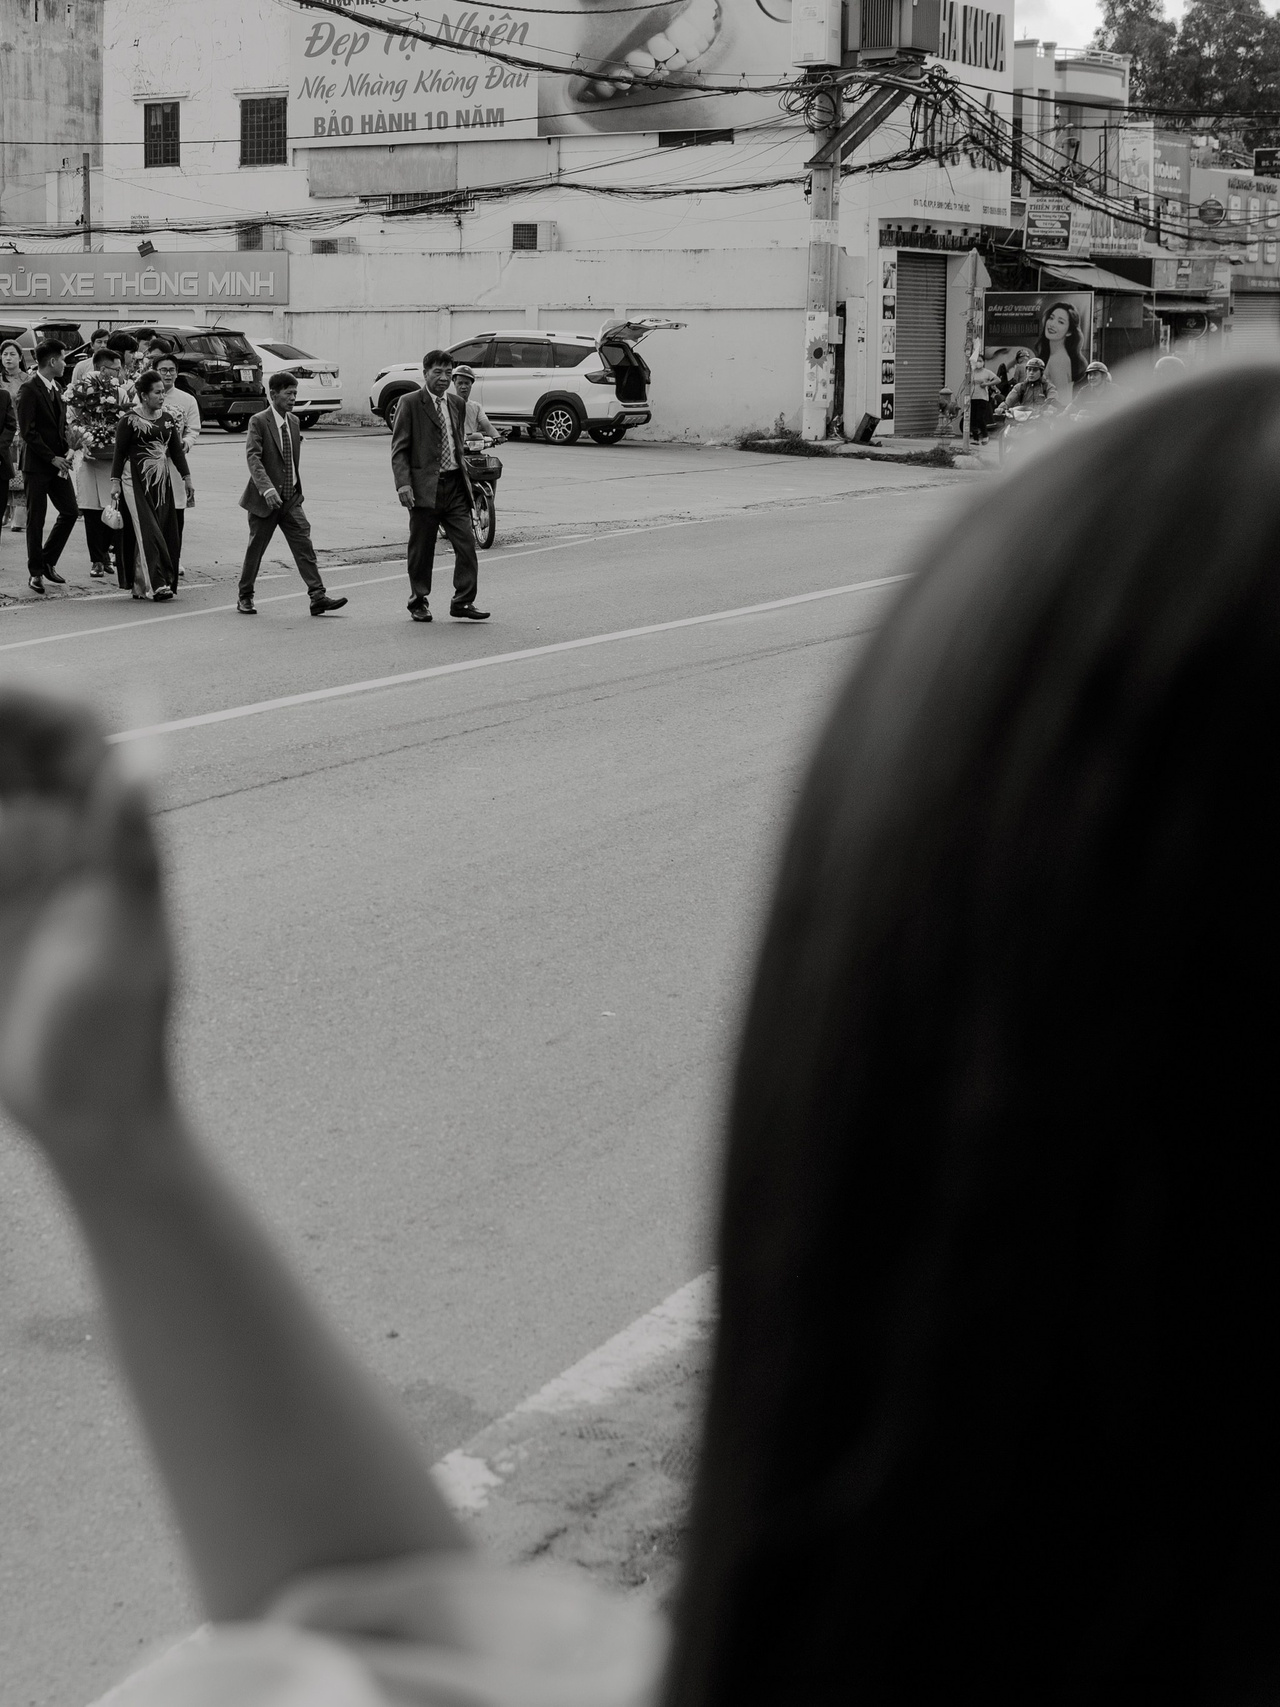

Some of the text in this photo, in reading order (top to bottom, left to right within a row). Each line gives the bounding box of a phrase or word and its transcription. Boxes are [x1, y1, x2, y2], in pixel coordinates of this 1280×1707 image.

[303, 20, 370, 67] Đẹp
[428, 11, 530, 51] Nhiên
[962, 5, 1007, 72] KHOA
[297, 65, 530, 104] Nhẹ Nhàng Không Đau
[313, 104, 505, 136] BẢO HÀNH 10 NĂM
[59, 272, 95, 297] XE
[103, 265, 199, 297] THÔNG
[208, 271, 275, 297] MINH
